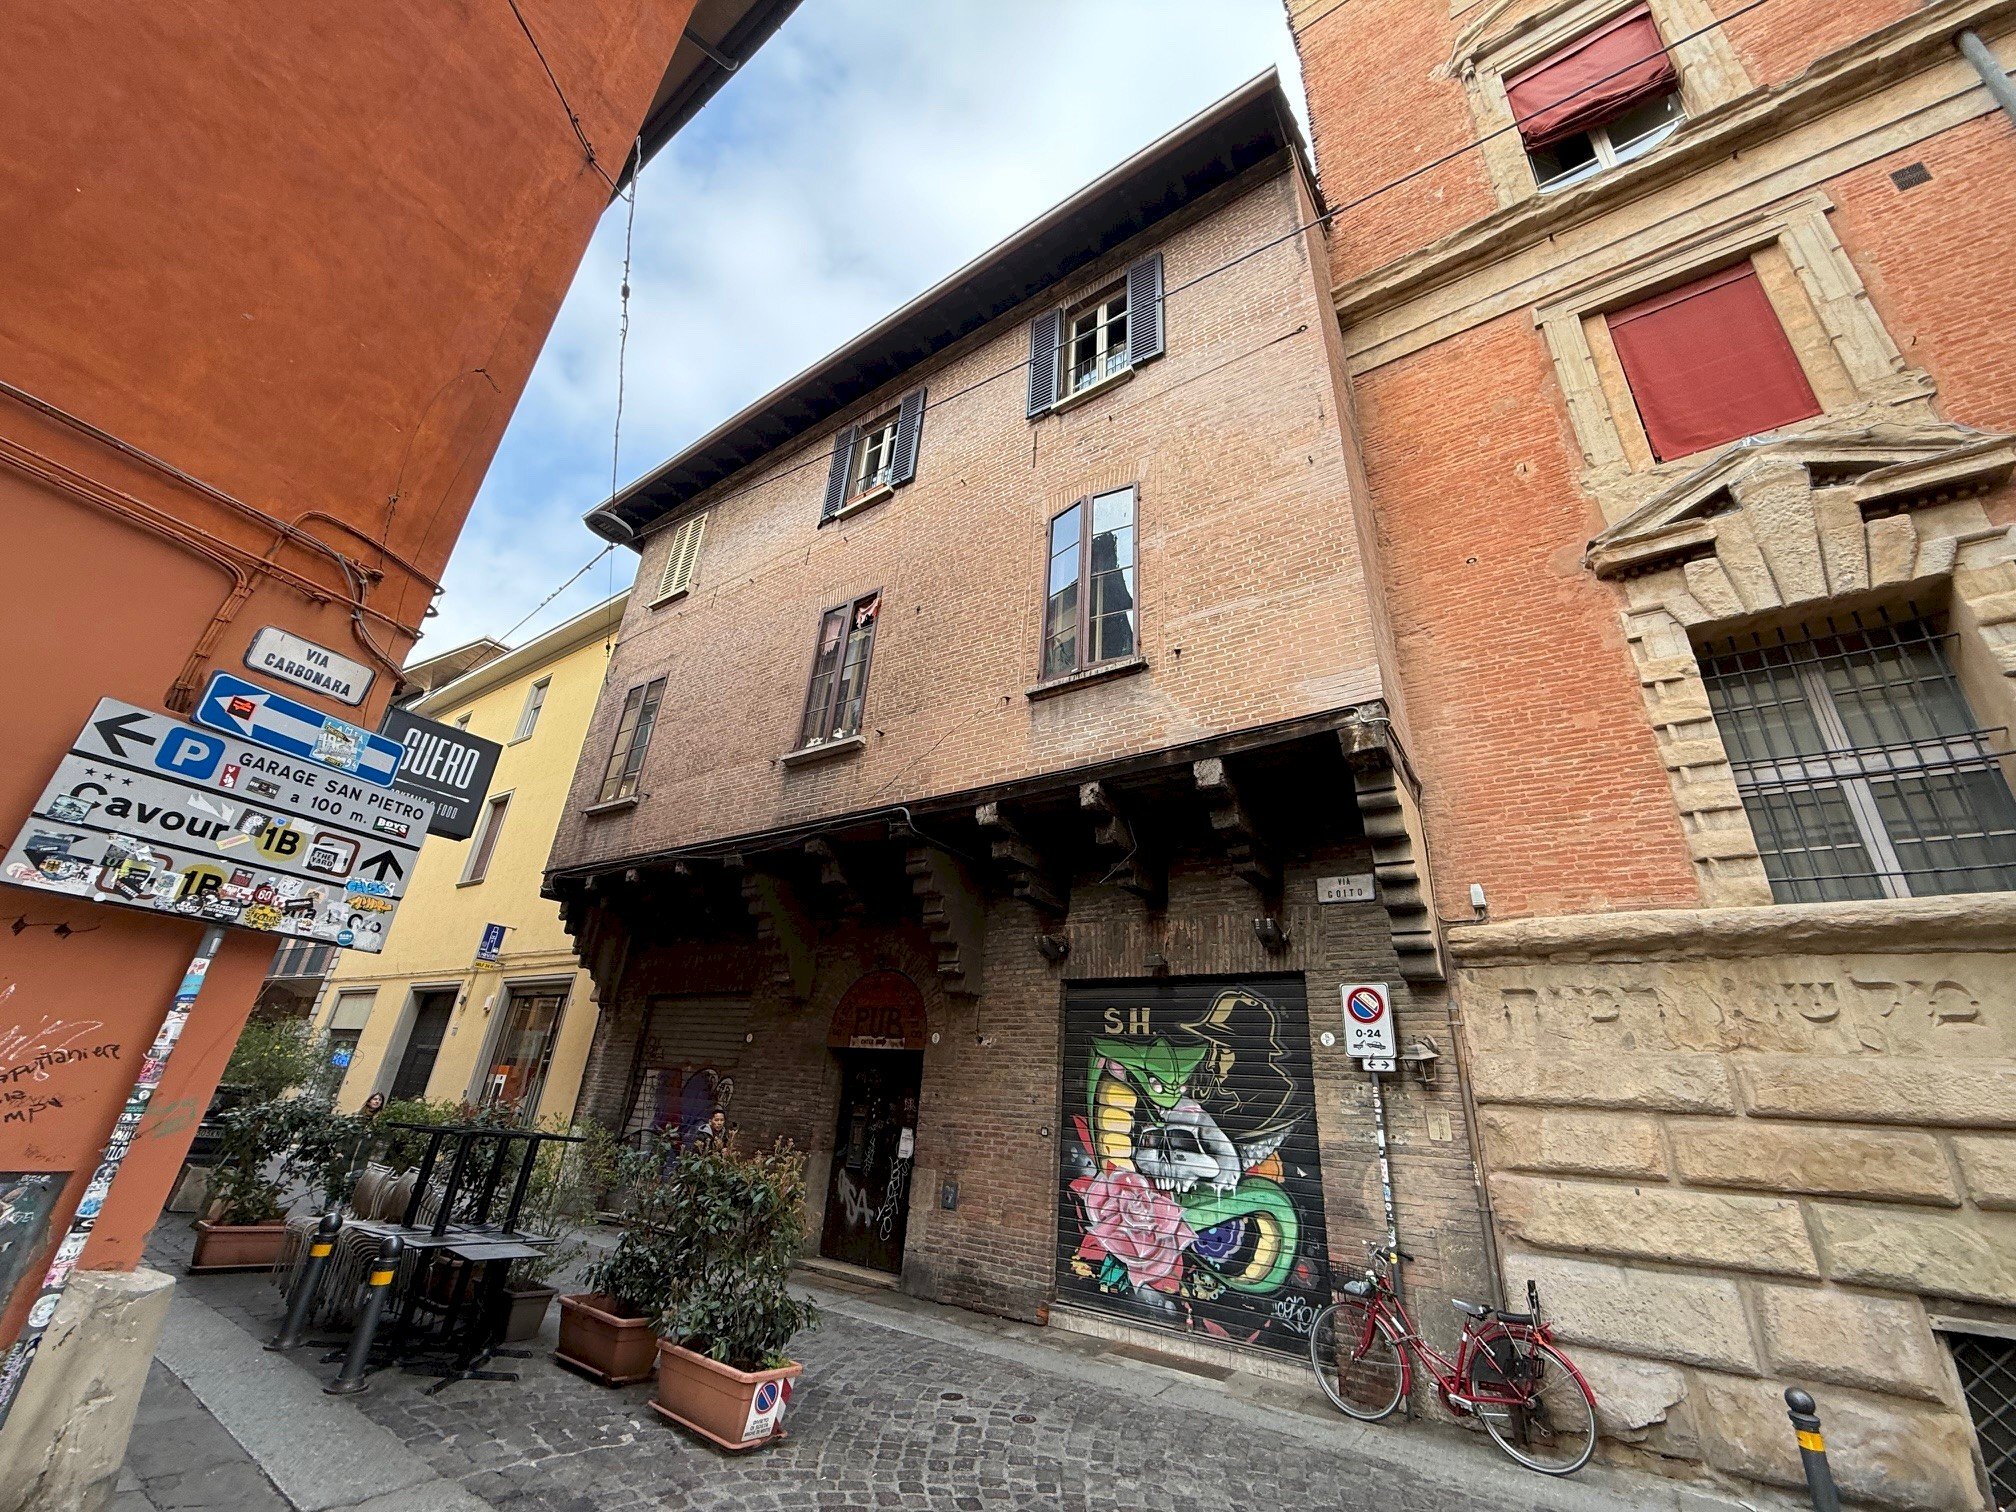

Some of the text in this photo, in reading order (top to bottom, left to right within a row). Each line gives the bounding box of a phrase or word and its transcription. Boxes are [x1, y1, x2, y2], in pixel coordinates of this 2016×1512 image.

[306, 648, 330, 669] VIA
[264, 652, 351, 698] CARBONARA
[238, 751, 318, 788] GARAGE
[324, 779, 363, 805] SAN
[368, 792, 425, 821] PIETRO
[68, 782, 231, 842] Cavour
[290, 793, 300, 804] a
[310, 796, 343, 815] 100
[376, 817, 409, 834] BOYS
[261, 826, 301, 856] 1B
[310, 856, 334, 868] YARD
[316, 851, 333, 861] THE
[1337, 877, 1351, 886] VIA
[1327, 888, 1363, 899] GOITO
[856, 1006, 904, 1036] PUB
[1355, 1028, 1382, 1038] 0-24
